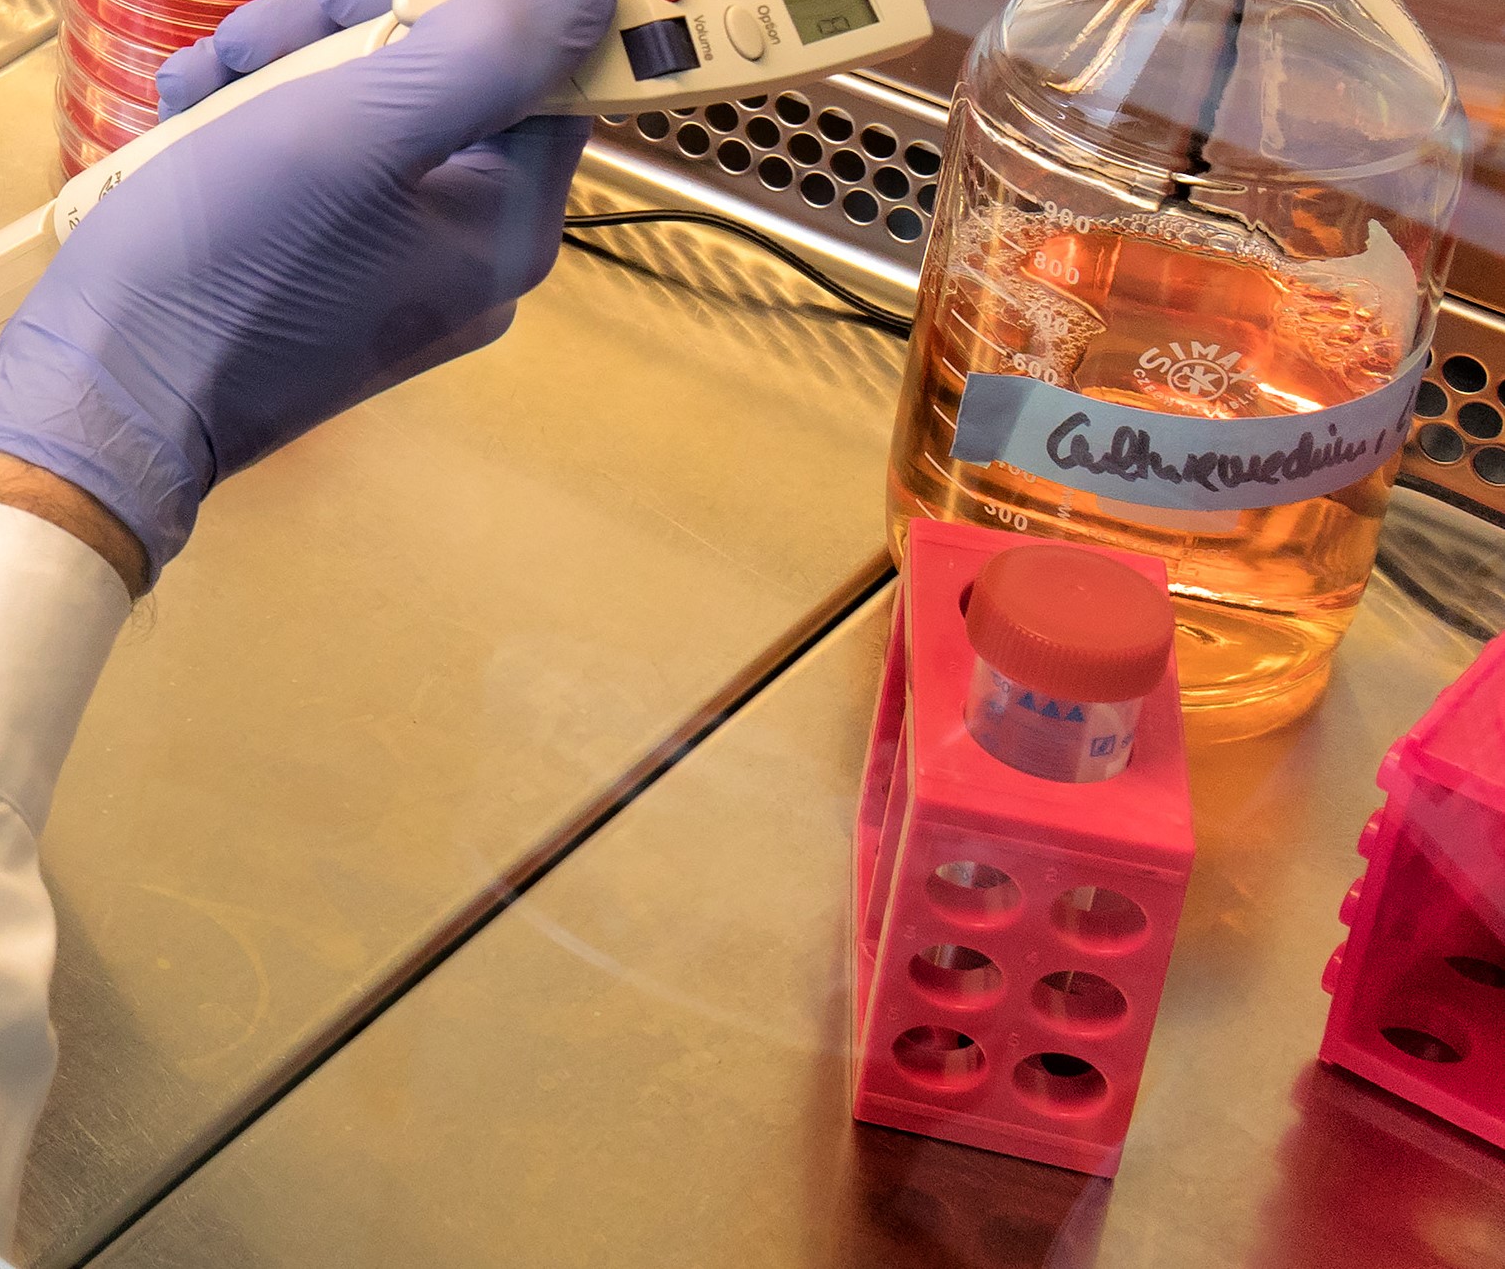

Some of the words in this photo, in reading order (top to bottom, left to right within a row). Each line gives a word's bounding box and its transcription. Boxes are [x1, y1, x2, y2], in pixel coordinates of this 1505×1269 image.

[693, 14, 714, 61] Volume
[757, 4, 782, 45] Option
[1043, 200, 1091, 235] 900
[1033, 251, 1080, 285] 800
[1012, 352, 1059, 386] 600
[1138, 340, 1257, 385] SIMAX
[983, 498, 1028, 532] 300
